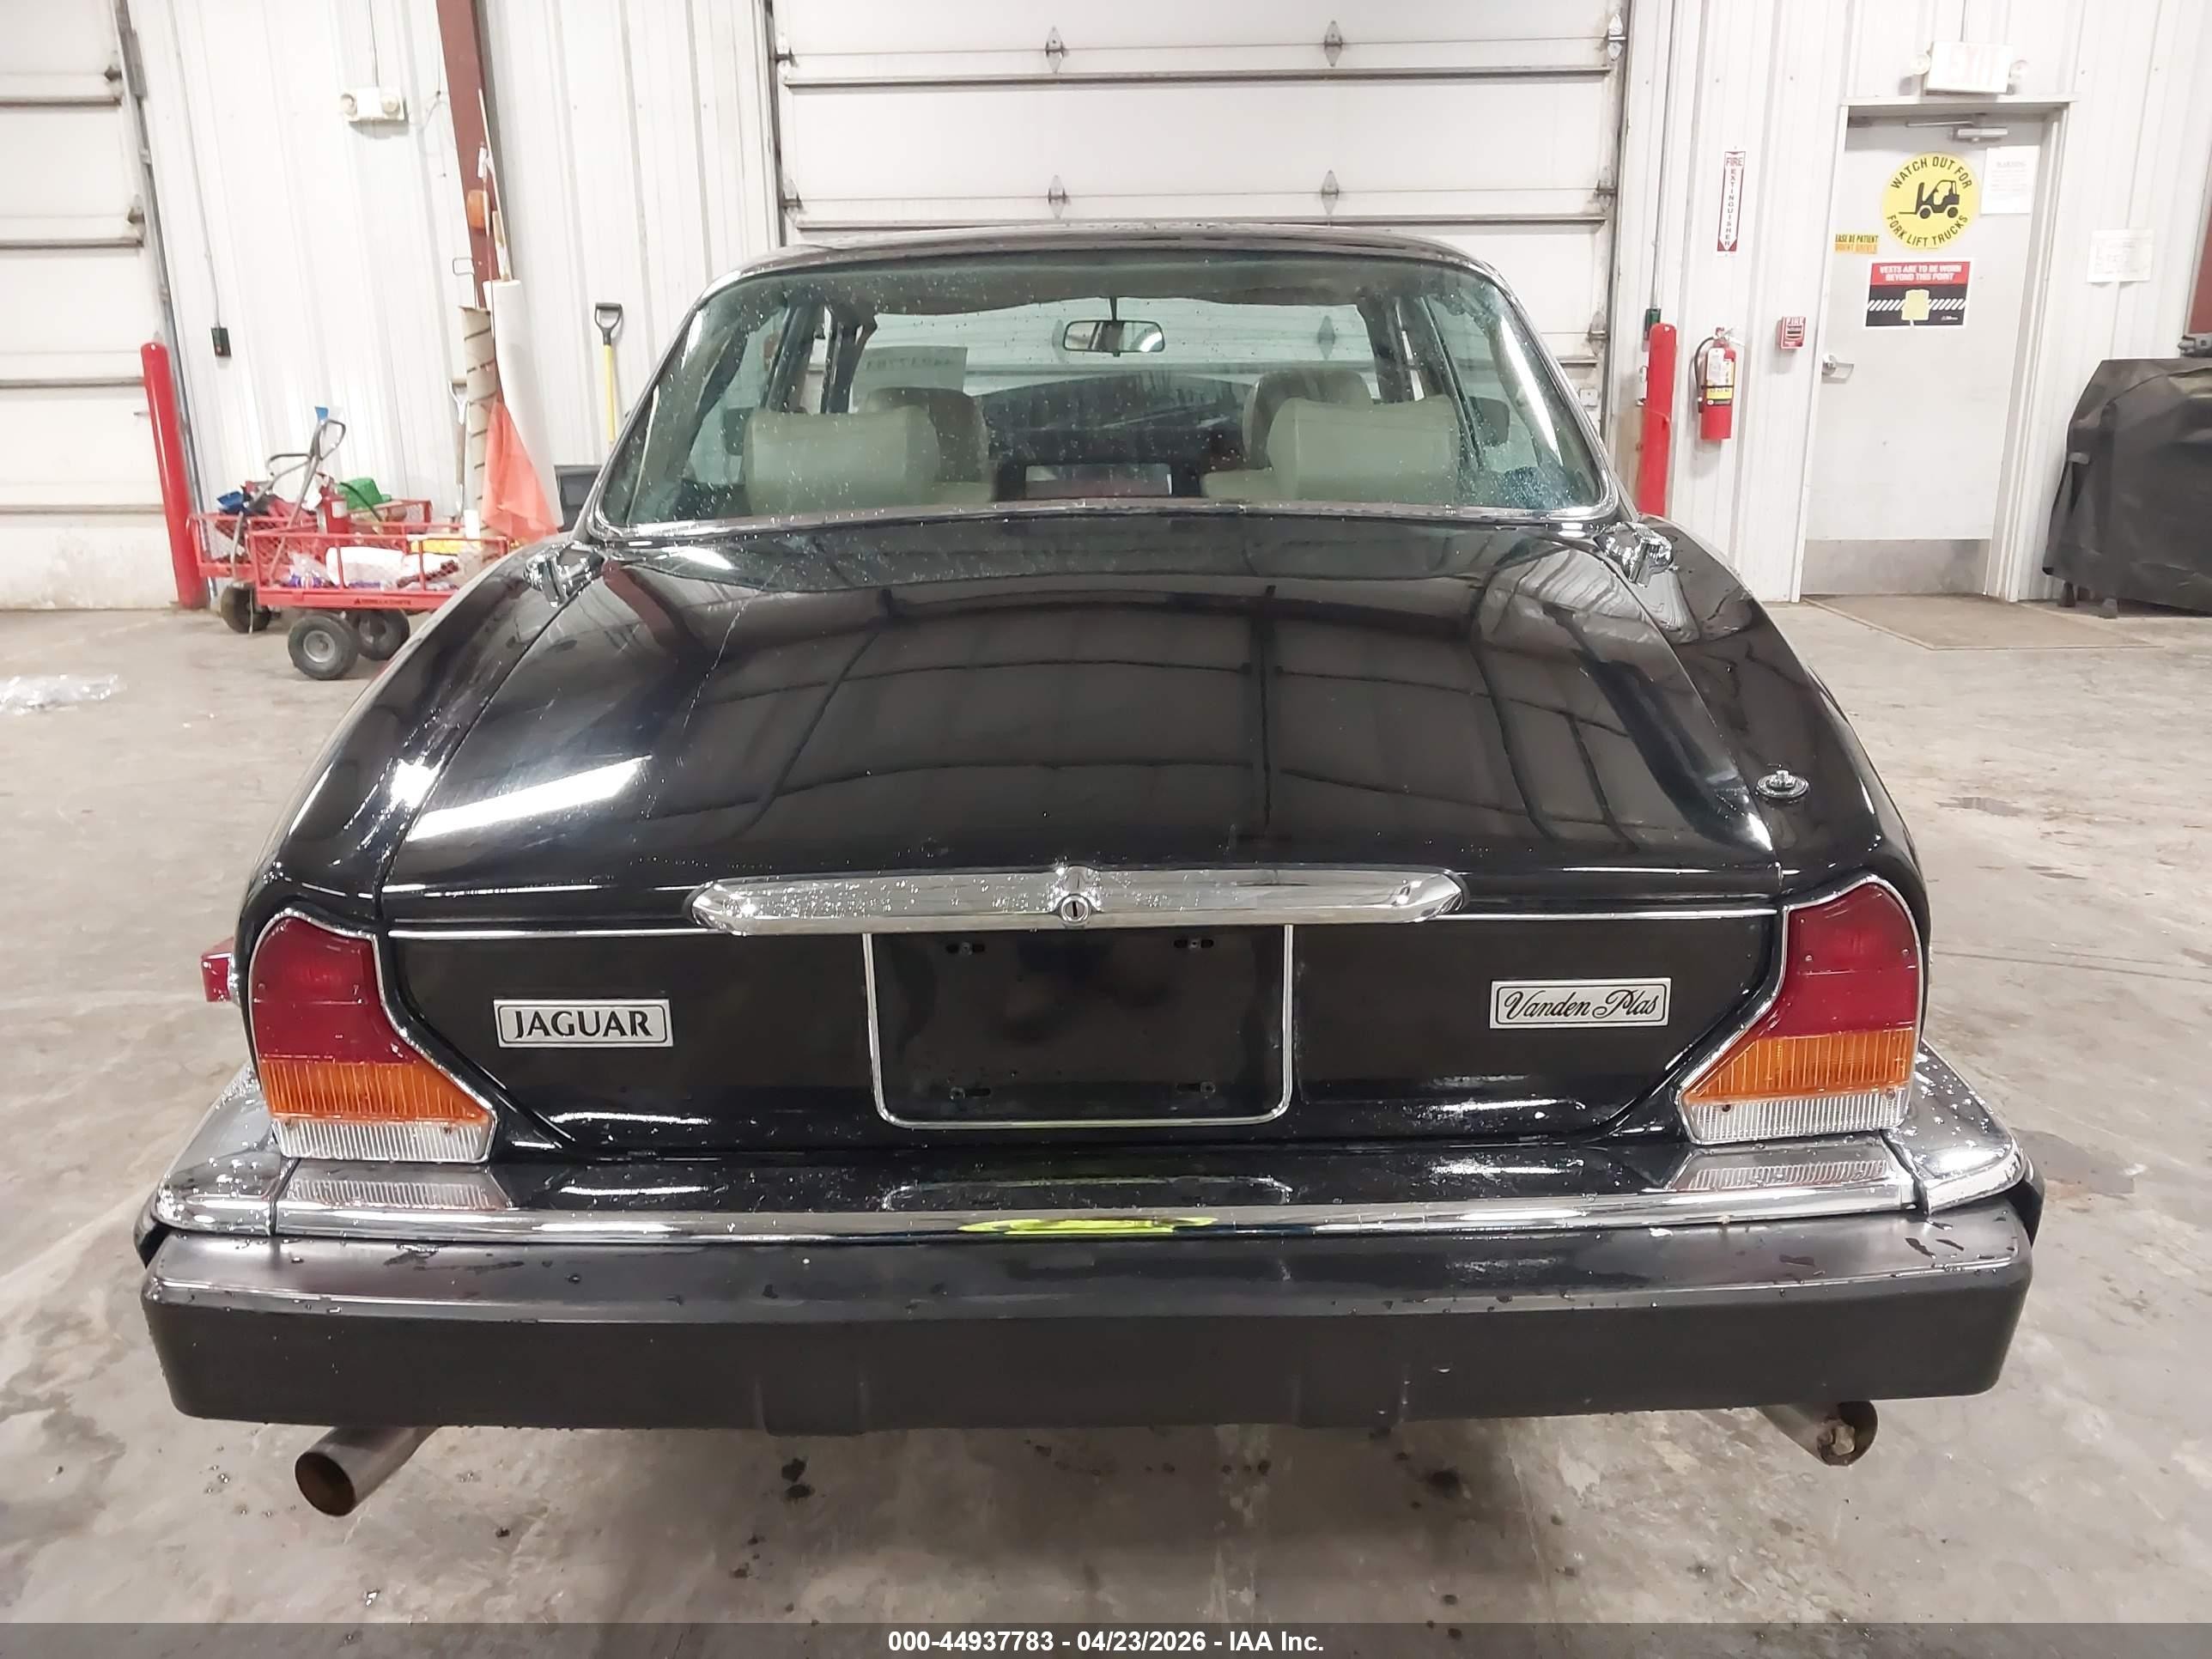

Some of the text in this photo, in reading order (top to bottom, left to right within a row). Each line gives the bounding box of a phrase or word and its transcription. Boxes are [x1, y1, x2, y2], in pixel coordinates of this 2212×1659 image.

[1726, 157, 1744, 167] FIRE
[1891, 157, 1928, 189] WATCH
[1932, 156, 1956, 170] OUT
[1954, 166, 1972, 189] FOR
[1887, 213, 1968, 247] FORK LIFT TRUCKS
[1504, 988, 1659, 1020] Vanden Plas
[514, 1010, 653, 1039] JAGUAR
